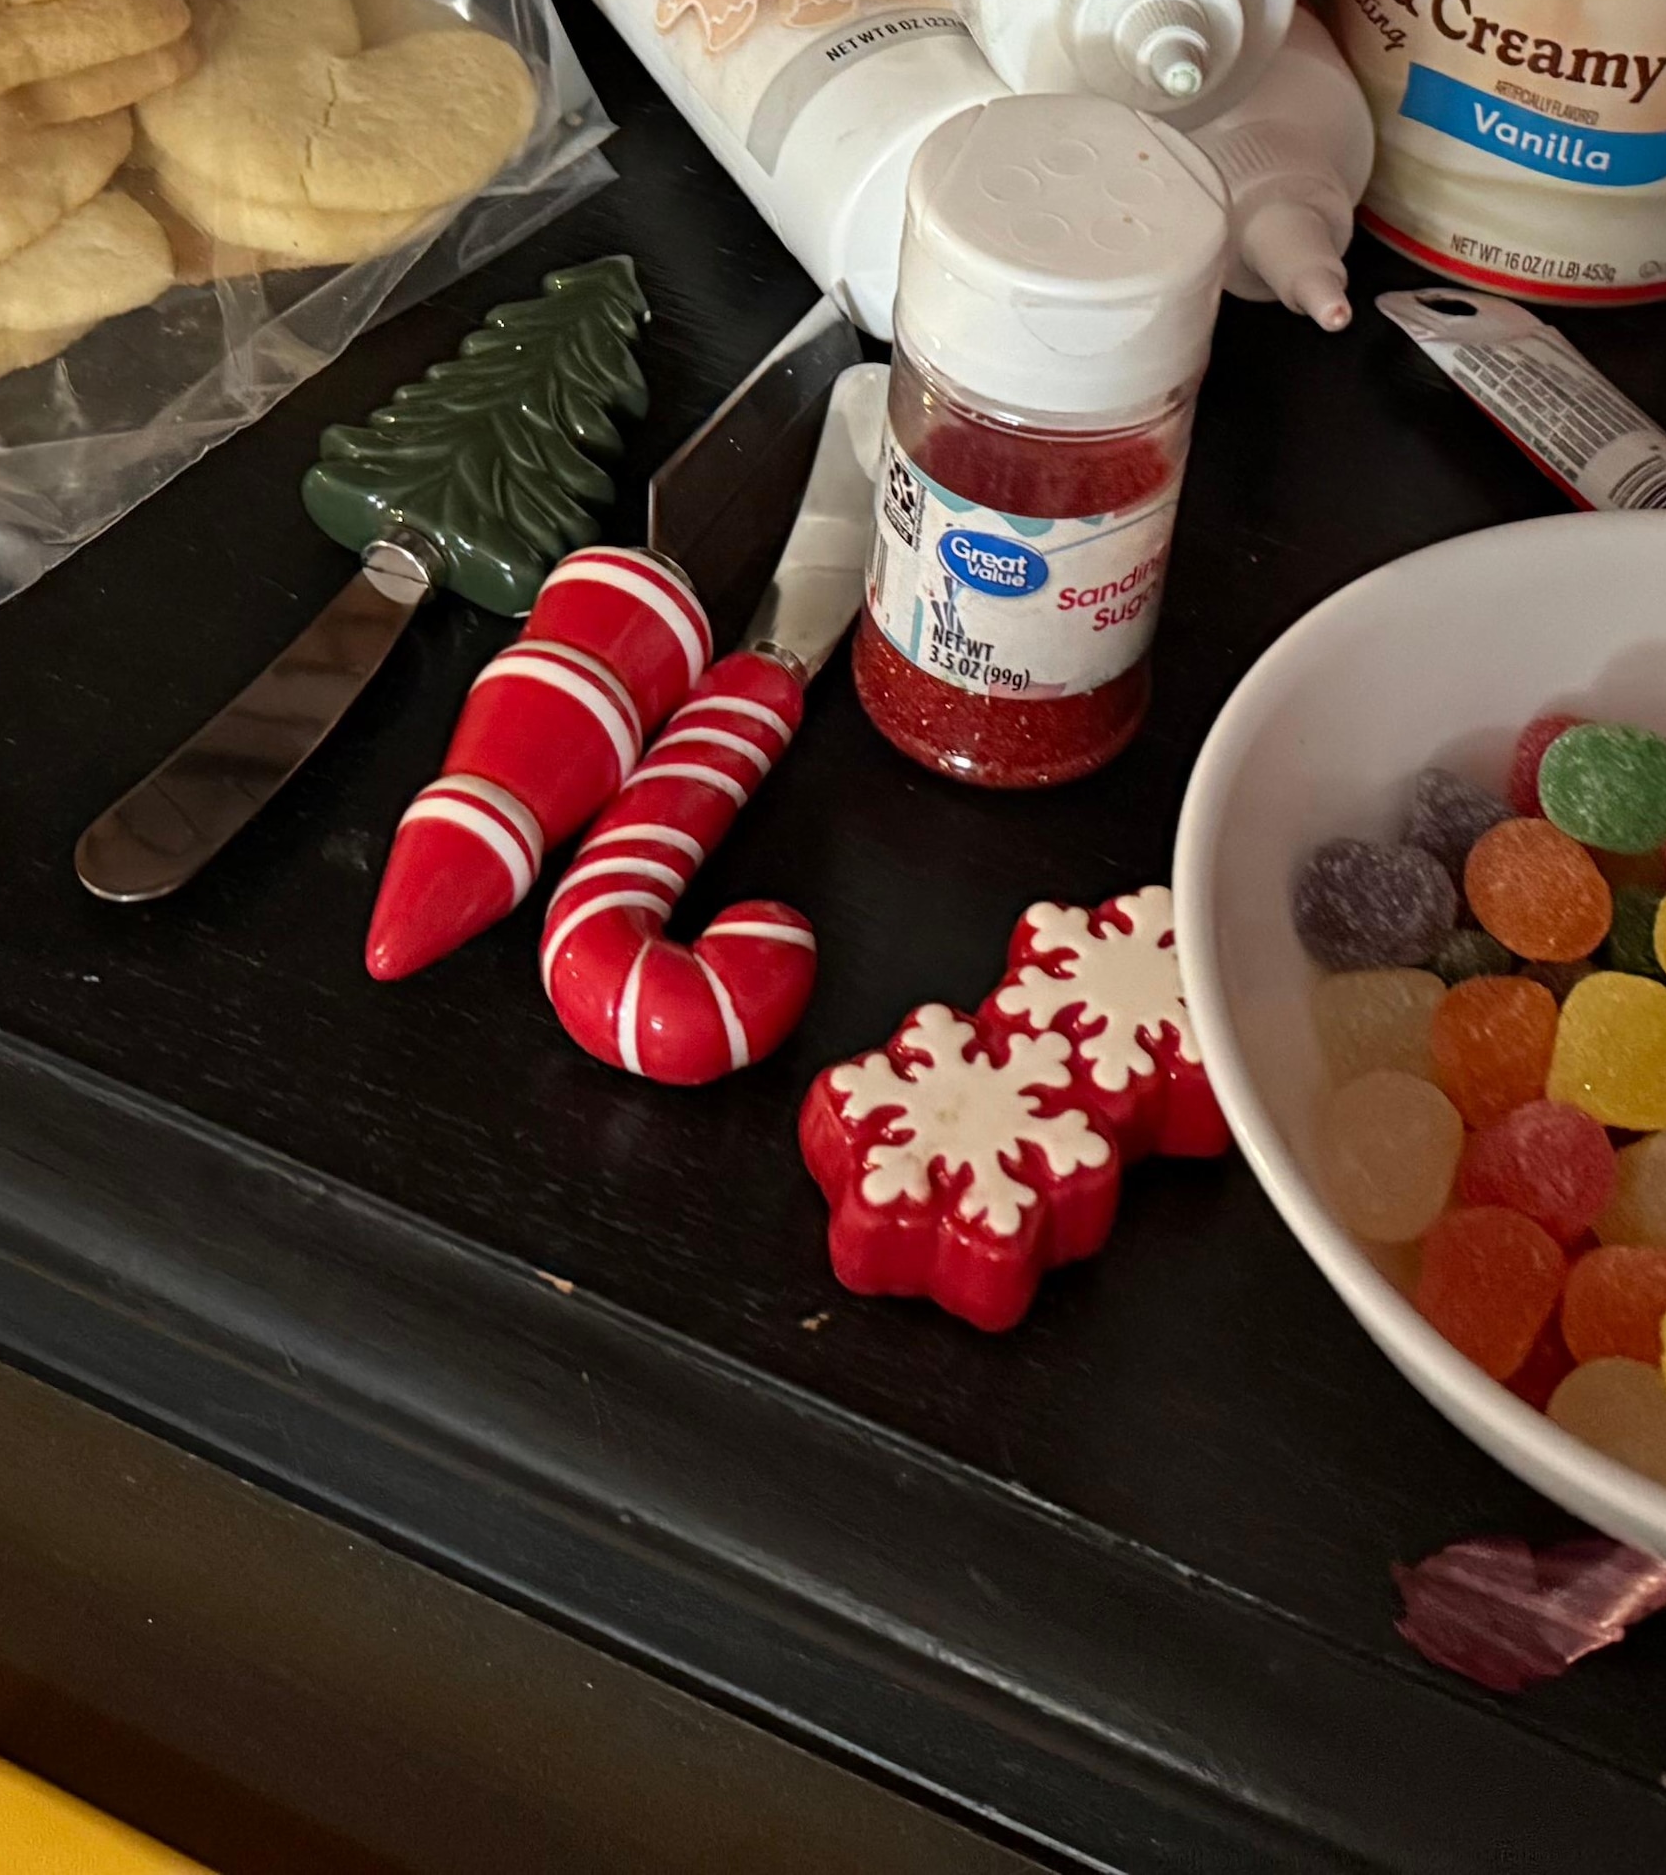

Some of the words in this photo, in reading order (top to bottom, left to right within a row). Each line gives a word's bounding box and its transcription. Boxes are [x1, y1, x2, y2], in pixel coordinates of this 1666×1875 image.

[825, 36, 859, 63] NET
[856, 27, 885, 45] WT
[898, 18, 924, 31] OZ
[1472, 101, 1612, 173] Vanilla
[1449, 233, 1478, 256] NET
[1479, 242, 1502, 265] WT
[1504, 251, 1521, 271] 16
[1521, 254, 1542, 275] OZ
[1542, 257, 1556, 277] (1
[1558, 260, 1580, 282] LB)
[949, 536, 1029, 576] Great
[966, 559, 1027, 589] Value
[1056, 556, 1163, 611] Sandin
[932, 624, 963, 655] NET
[965, 636, 996, 663] WT
[929, 644, 955, 671] 3.5
[958, 657, 981, 681] OZ
[983, 663, 1031, 692] (99g)
